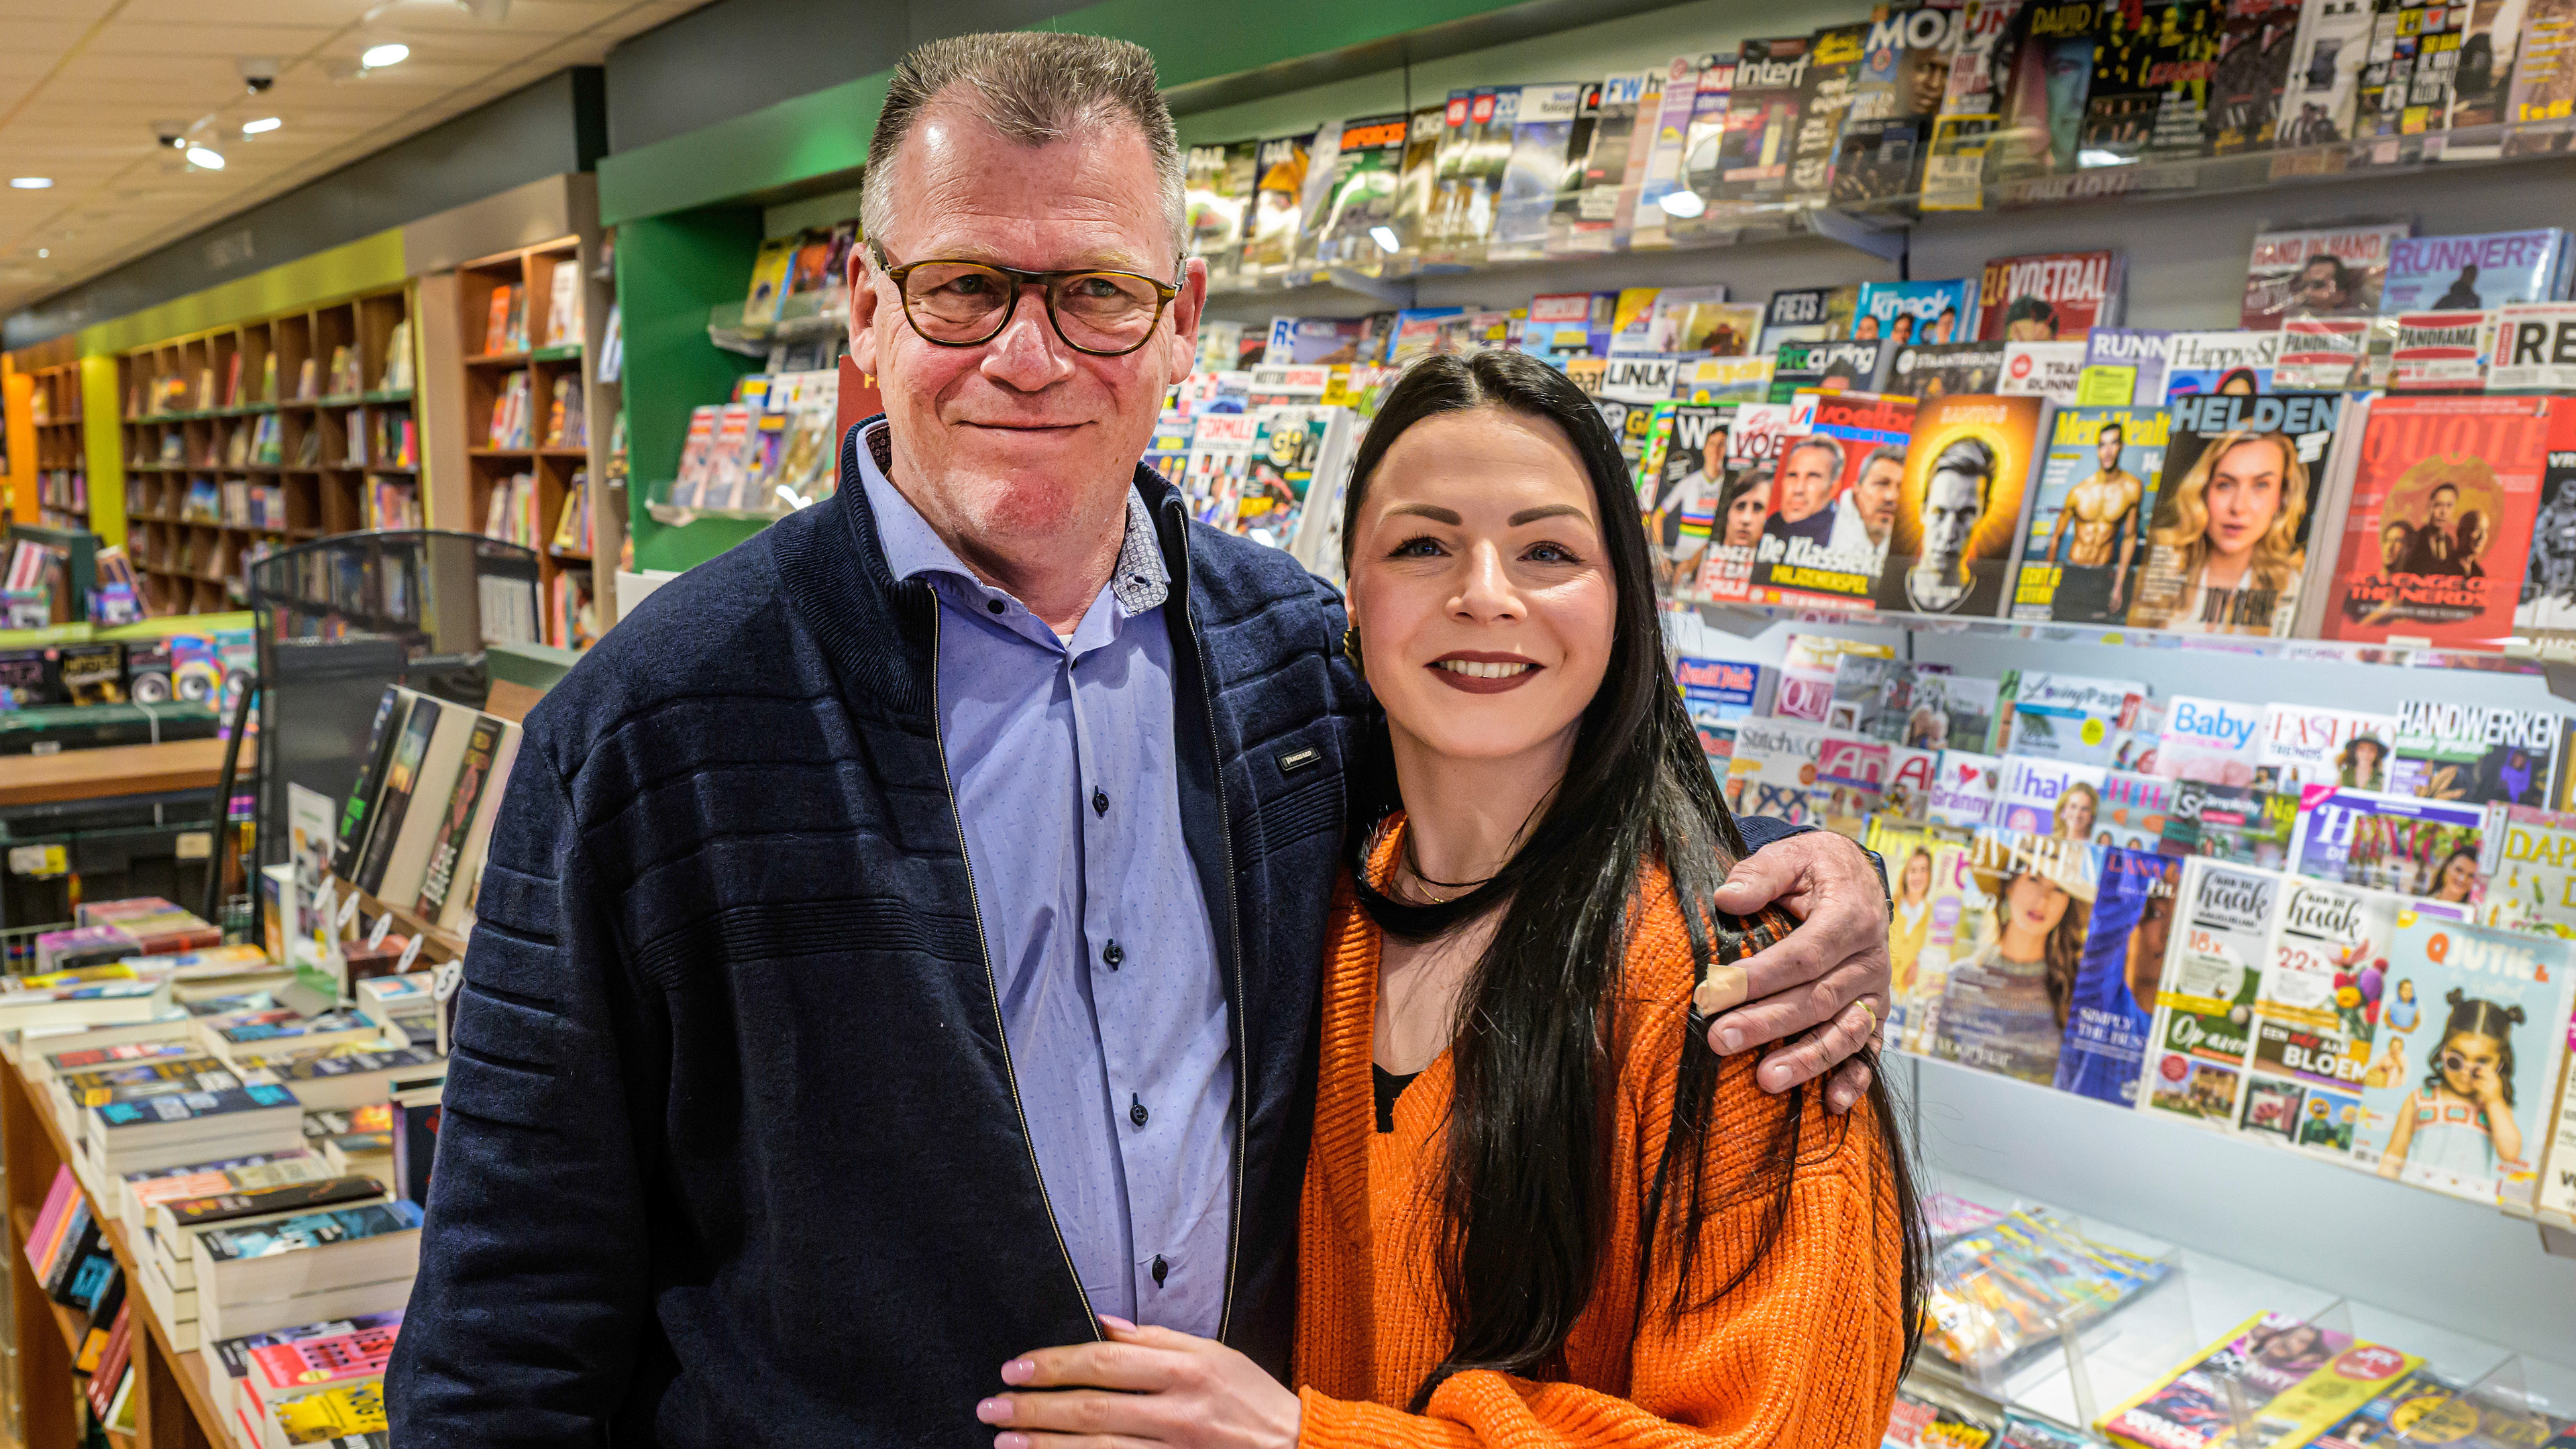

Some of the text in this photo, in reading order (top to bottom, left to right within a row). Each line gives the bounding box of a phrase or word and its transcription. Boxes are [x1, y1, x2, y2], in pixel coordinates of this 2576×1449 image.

[2390, 233, 2552, 274] RUNNER'S
[1775, 293, 1817, 325] FIETS
[2398, 325, 2478, 349] PANORAMA
[1608, 360, 1672, 388] LINUX
[2174, 396, 2339, 435] HELDEN
[2363, 413, 2551, 478] QUOTE
[1757, 534, 1787, 563] De
[2175, 702, 2256, 751] Baby
[2396, 699, 2565, 750] HANDWERKEN
[1285, 750, 1312, 765] VANGUARD
[2196, 870, 2269, 922] haak
[2288, 885, 2363, 939] haak
[2426, 932, 2536, 981] QJUTIE
[2081, 1006, 2134, 1031] SIMPLY
[2261, 1026, 2290, 1043] EEN
[2319, 1040, 2350, 1056] AAN
[2282, 1042, 2369, 1081] BLOEM
